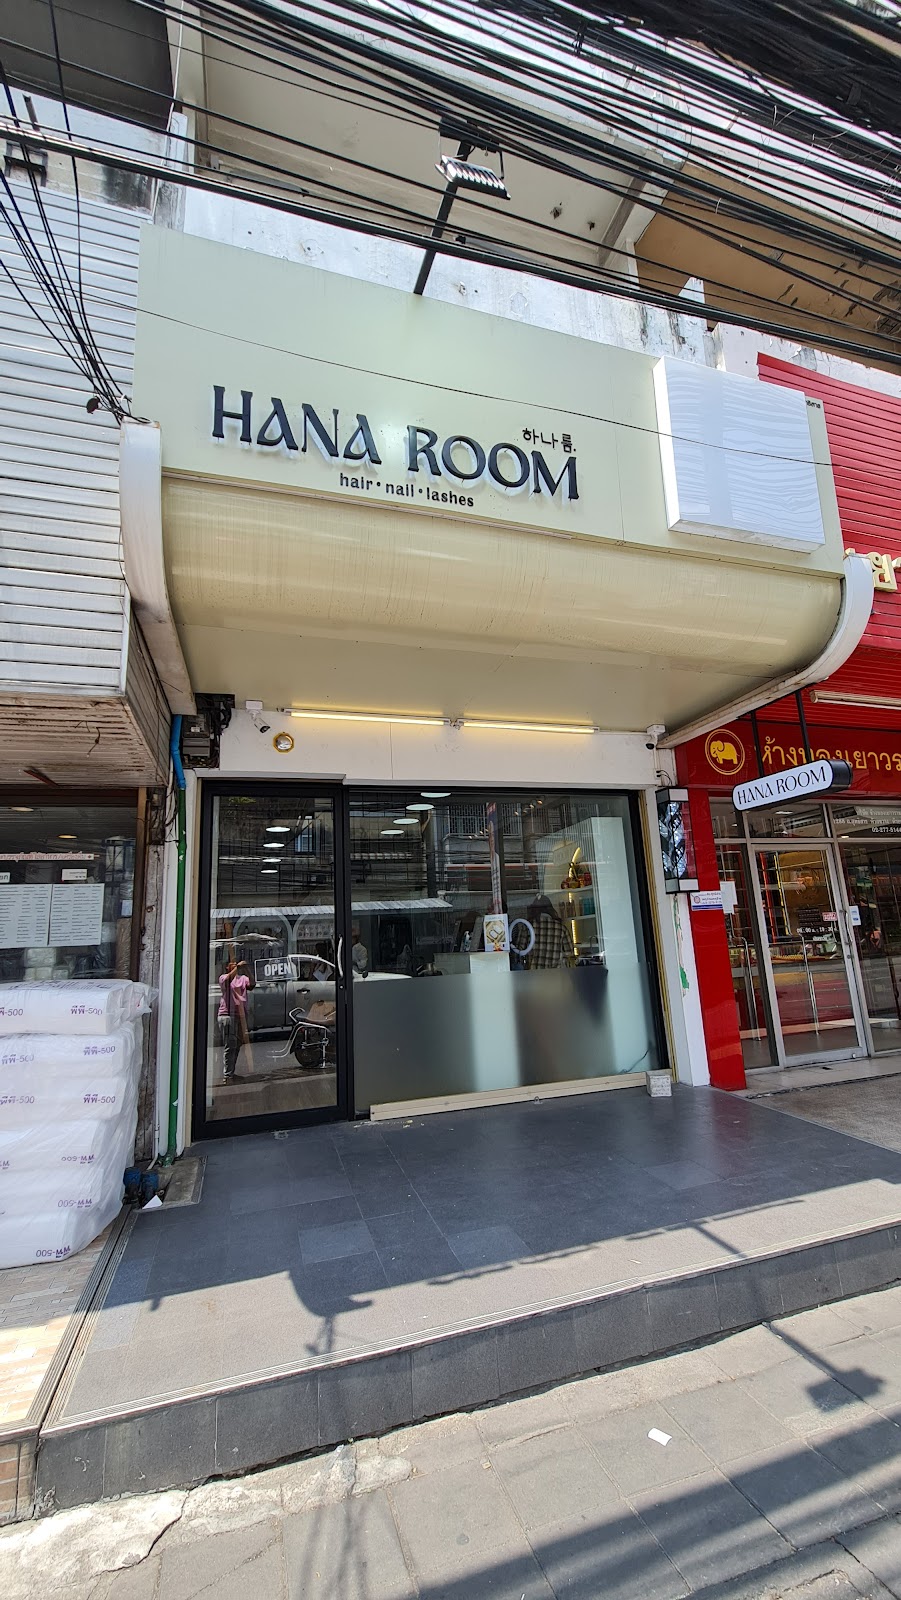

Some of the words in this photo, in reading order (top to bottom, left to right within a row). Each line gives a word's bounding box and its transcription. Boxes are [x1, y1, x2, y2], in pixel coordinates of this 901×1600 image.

[212, 384, 382, 465] HANA
[406, 424, 580, 501] ROOM
[737, 782, 774, 805] HANA
[775, 766, 827, 794] ROOM
[264, 962, 292, 976] OPEN
